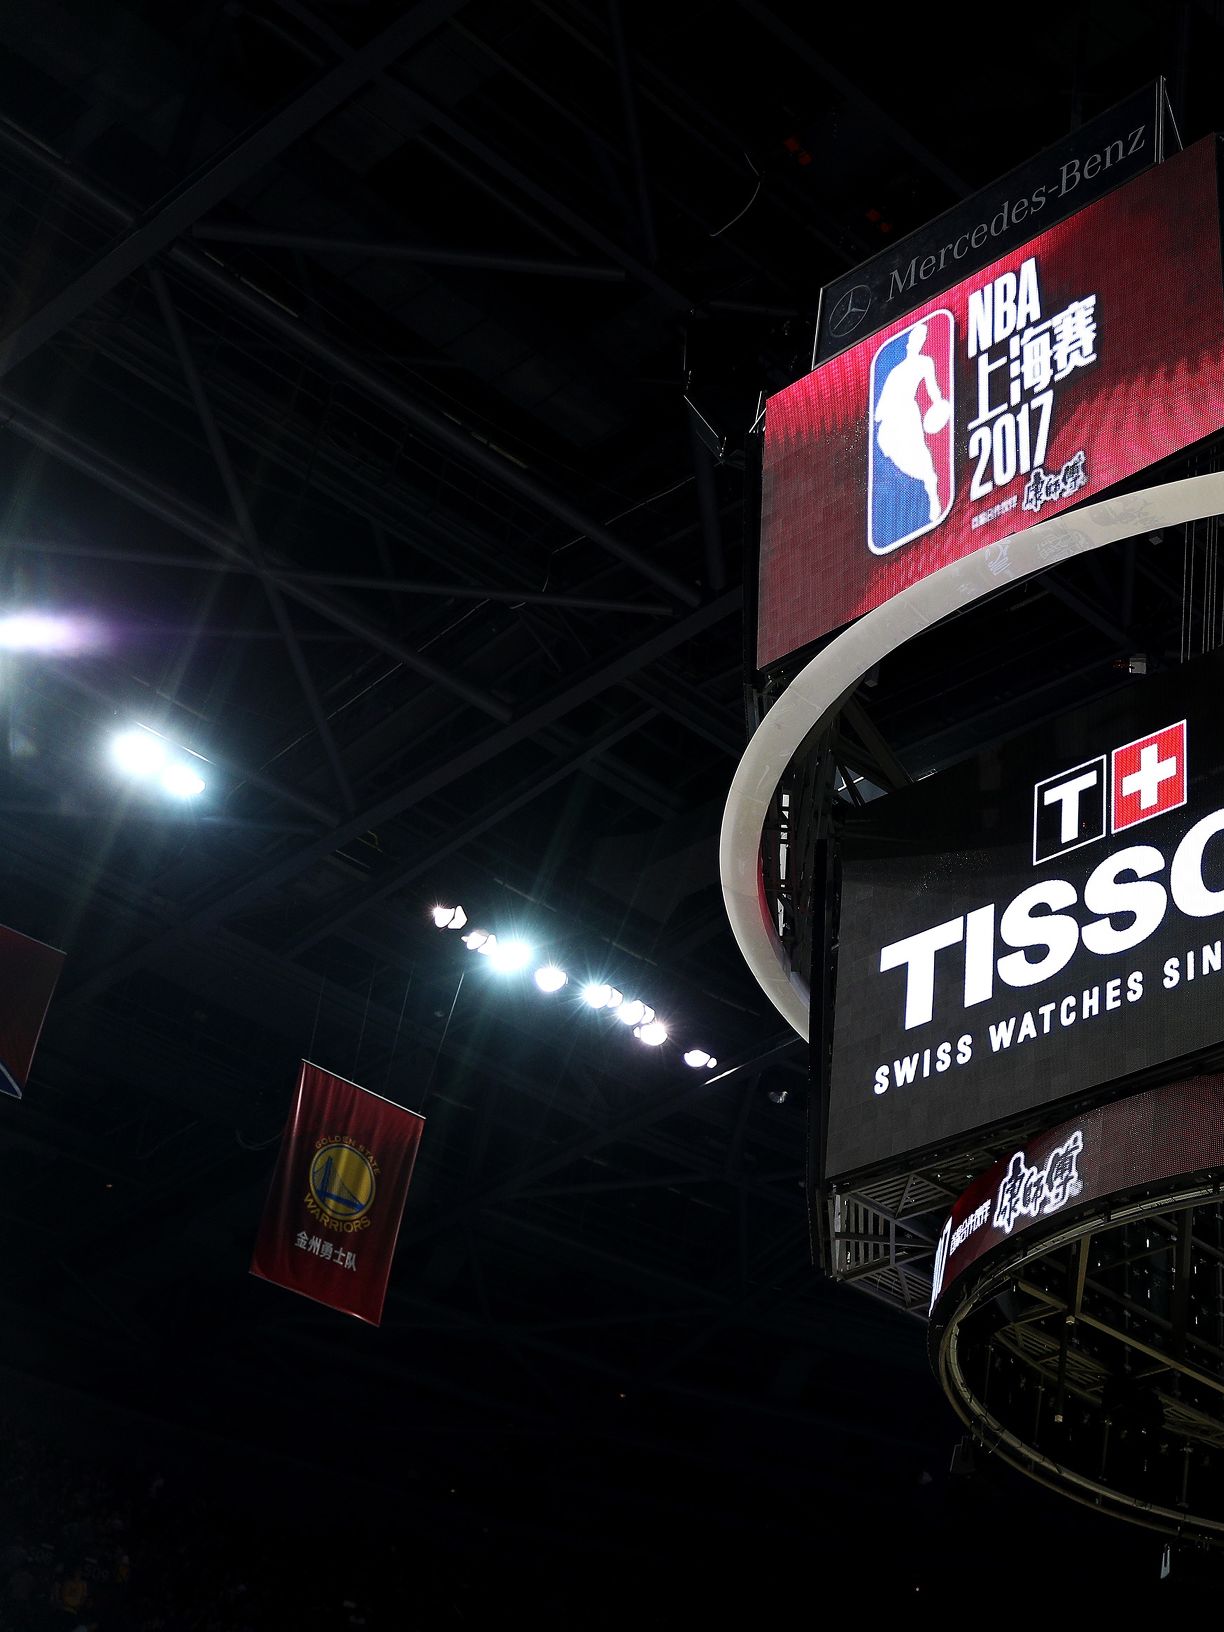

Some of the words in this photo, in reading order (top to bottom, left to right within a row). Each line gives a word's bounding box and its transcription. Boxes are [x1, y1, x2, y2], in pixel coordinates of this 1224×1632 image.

[888, 124, 1147, 302] Mercedes-Benz
[968, 257, 1041, 360] NBA
[968, 295, 1097, 431] 上海赛
[968, 390, 1054, 501] 2017
[873, 1033, 973, 1096] SWISS
[988, 970, 1144, 1053] WATCHES
[314, 1135, 356, 1150] GOLDEN
[294, 1230, 357, 1271] 金州勇士队
[303, 1192, 371, 1233] WARRIORS
